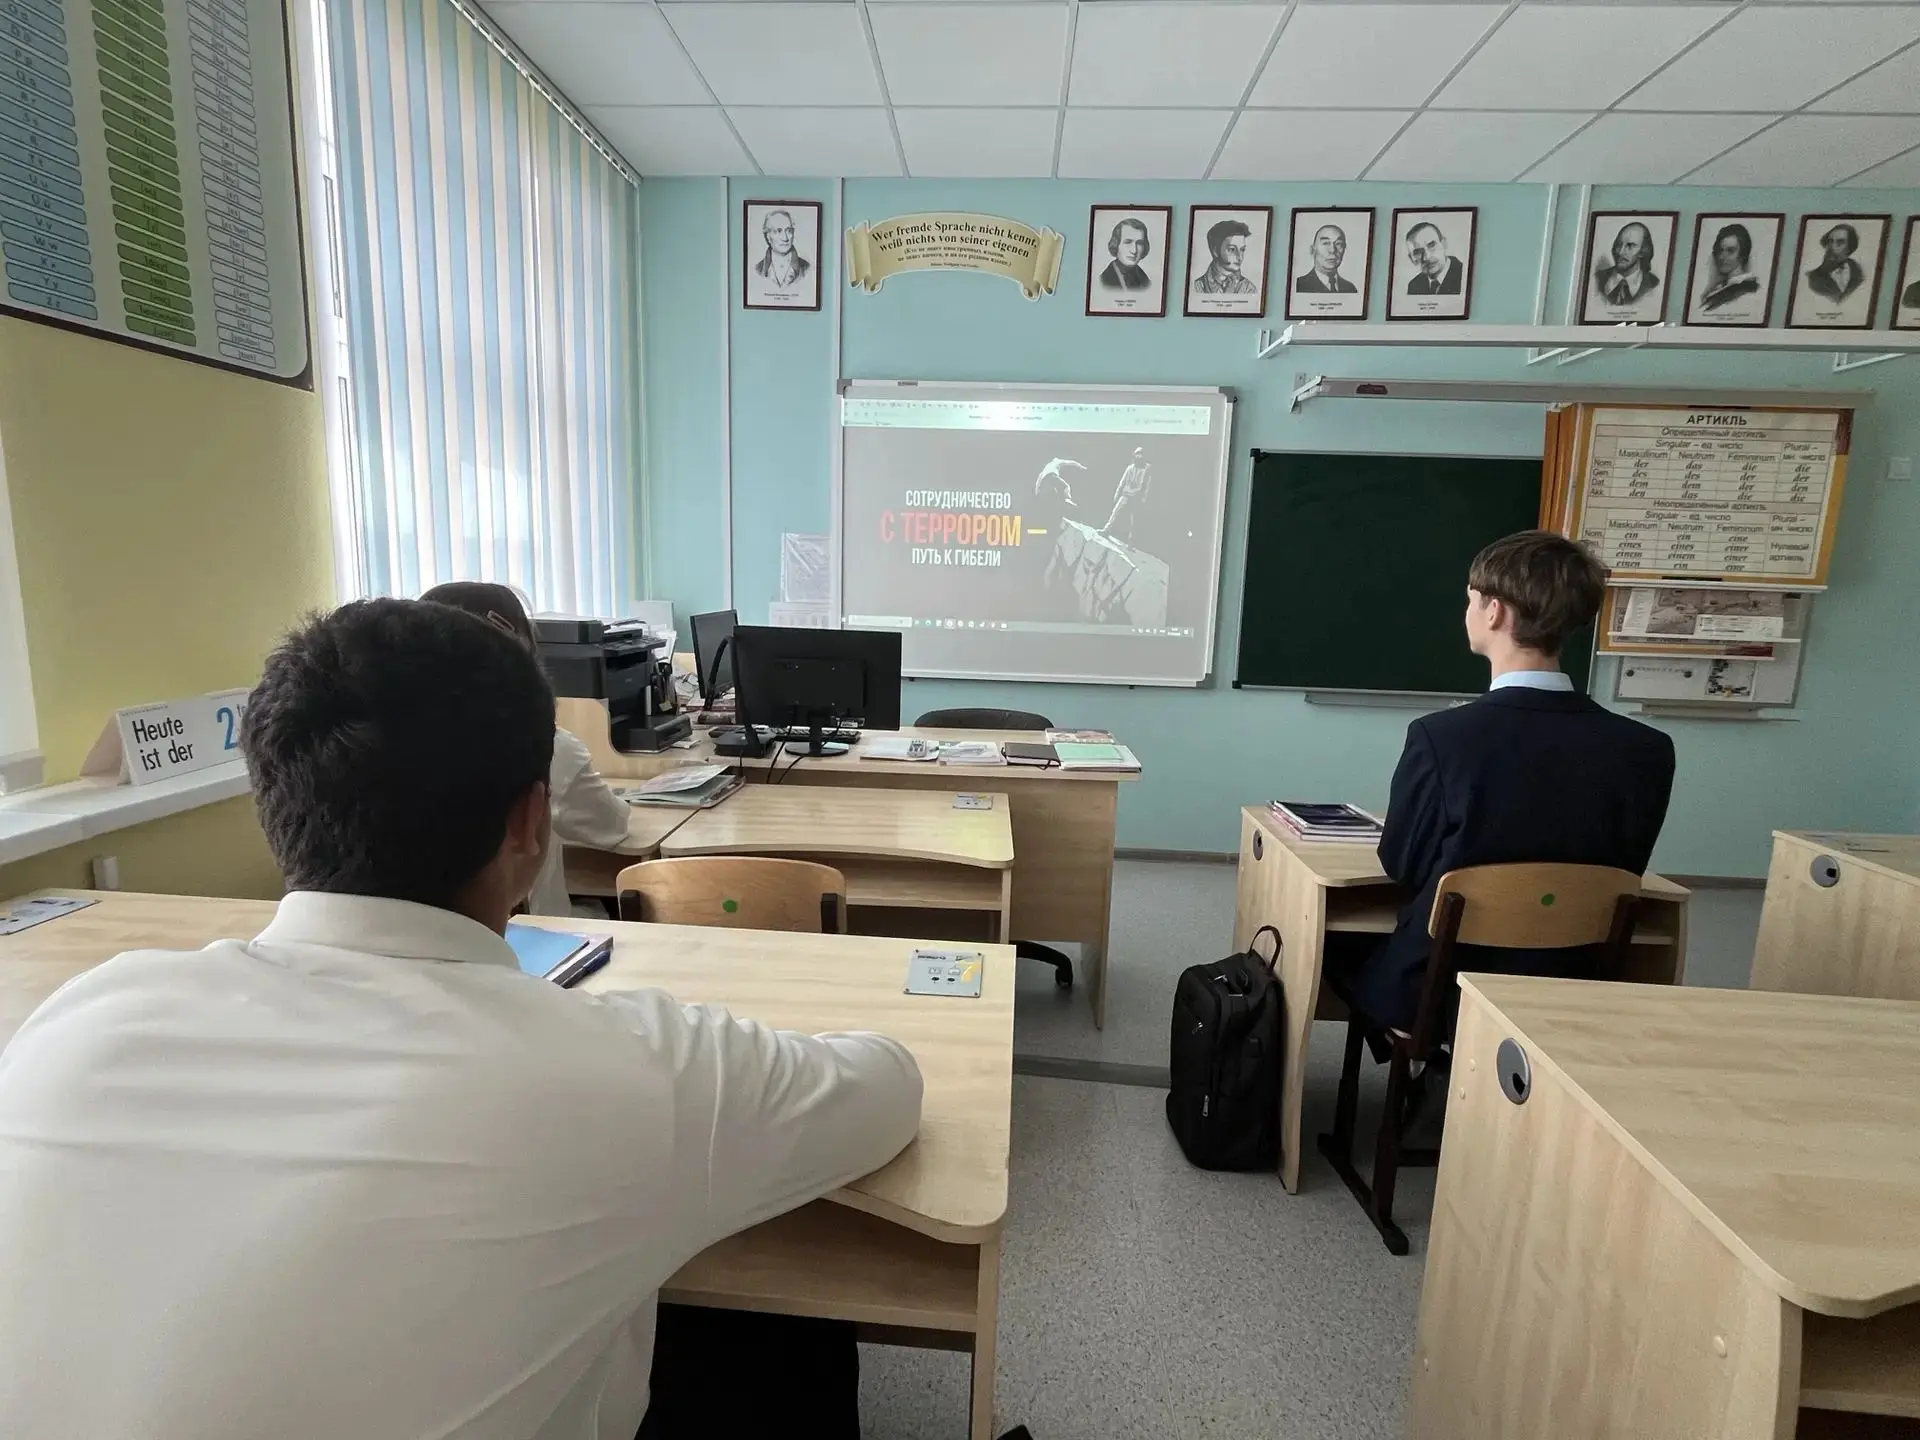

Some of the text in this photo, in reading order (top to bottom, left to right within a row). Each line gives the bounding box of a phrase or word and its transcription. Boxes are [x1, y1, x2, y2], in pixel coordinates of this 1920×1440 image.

[872, 221, 1037, 248] Wer fremde Sprache nicht kennt,
[33, 236, 45, 246] W
[880, 234, 1029, 258] weiß nichts von seiner eigenen
[1687, 415, 1747, 425] АРТИКЛЬ
[1656, 440, 1691, 449] Singular
[1784, 442, 1810, 451] Plural
[1619, 449, 1775, 461] Maskulinum Neutrum Femininum
[1634, 459, 1649, 468] der
[1686, 461, 1703, 469] das
[1742, 462, 1758, 471] die
[1795, 464, 1811, 472] die
[1685, 471, 1700, 480] des
[1740, 472, 1756, 481] der
[1793, 474, 1810, 482] der
[1629, 480, 1648, 488] dem
[1682, 480, 1701, 489] dem
[1738, 482, 1755, 490] der
[1791, 484, 1808, 492] den
[905, 490, 1011, 509] СОТРУДНИЧЕСТВО
[1629, 489, 1645, 497] den
[1682, 490, 1698, 498] das
[1737, 492, 1752, 500] die
[1790, 493, 1806, 502] die
[1645, 510, 1679, 520] Singular
[1773, 514, 1797, 522] Plural
[880, 510, 894, 543] С
[901, 512, 1022, 547] ТЕРРОРОМ
[1609, 520, 1763, 532] Maskulinum Neutrum Femininum
[912, 548, 1001, 567] ПУТЬ К ГИБЕЛИ
[1668, 552, 1696, 560] einem
[132, 717, 184, 744] Heute
[140, 740, 193, 771] ist der
